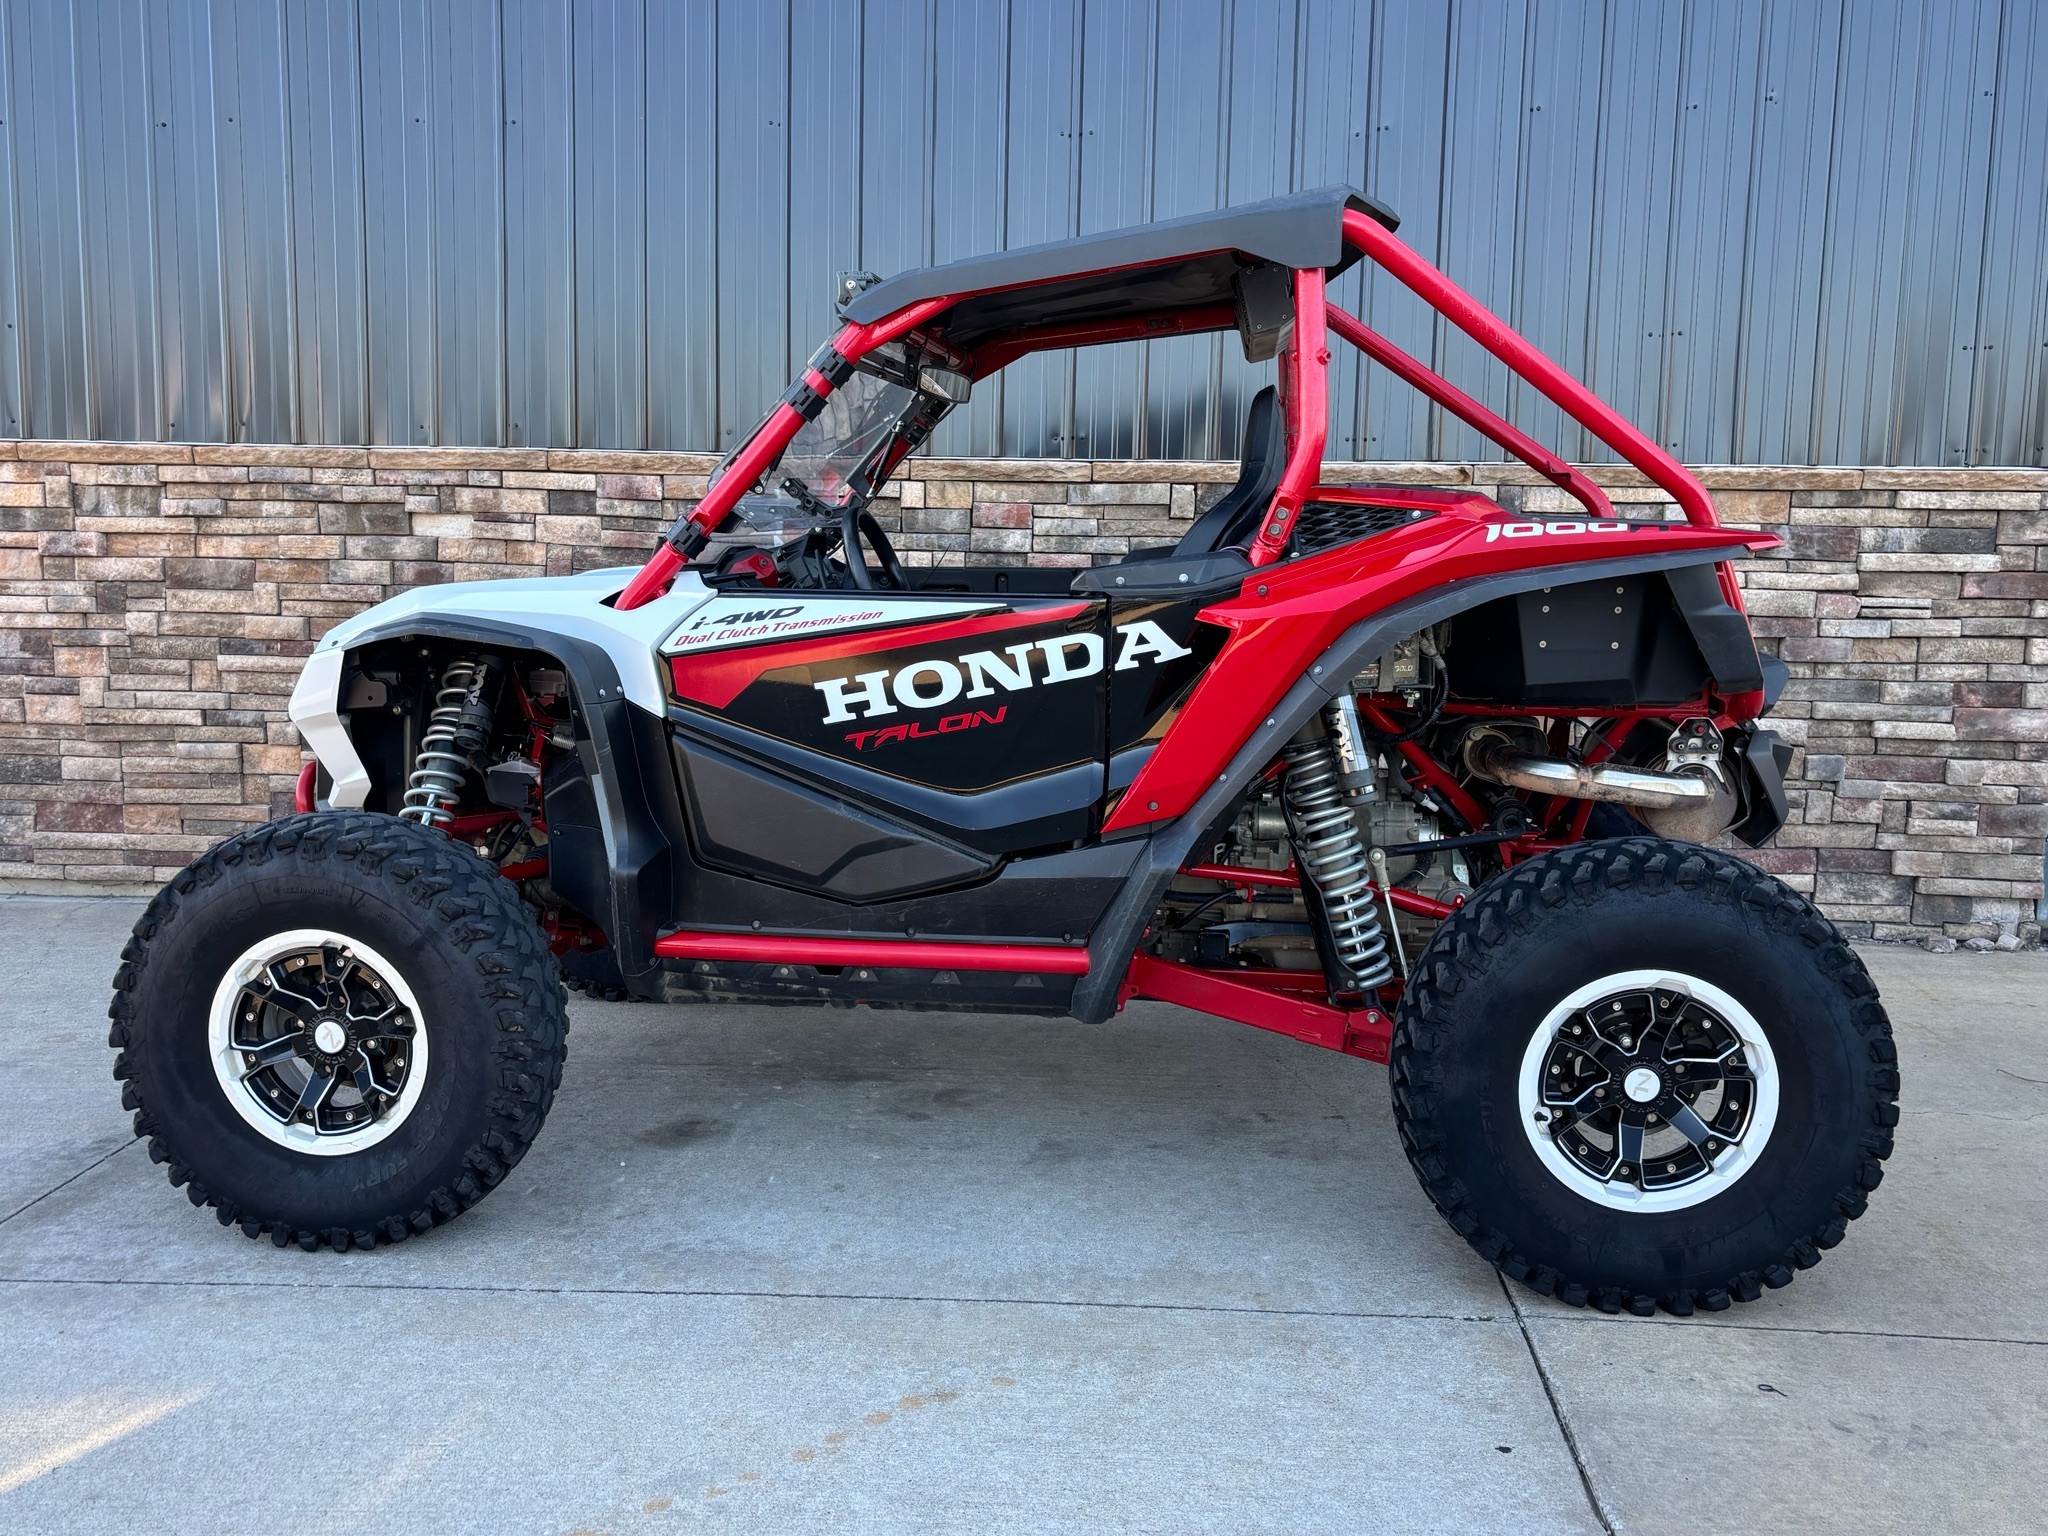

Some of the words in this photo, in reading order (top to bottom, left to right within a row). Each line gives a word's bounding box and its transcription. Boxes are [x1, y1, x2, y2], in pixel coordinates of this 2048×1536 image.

[674, 631, 715, 647] Dual
[716, 624, 769, 640] Clutch
[770, 611, 884, 633] Transmission
[689, 606, 805, 631] i-4WD
[463, 664, 488, 706] FOX
[814, 620, 1192, 725] HONDA
[844, 705, 1008, 751] TALON
[1326, 709, 1355, 764] FOX
